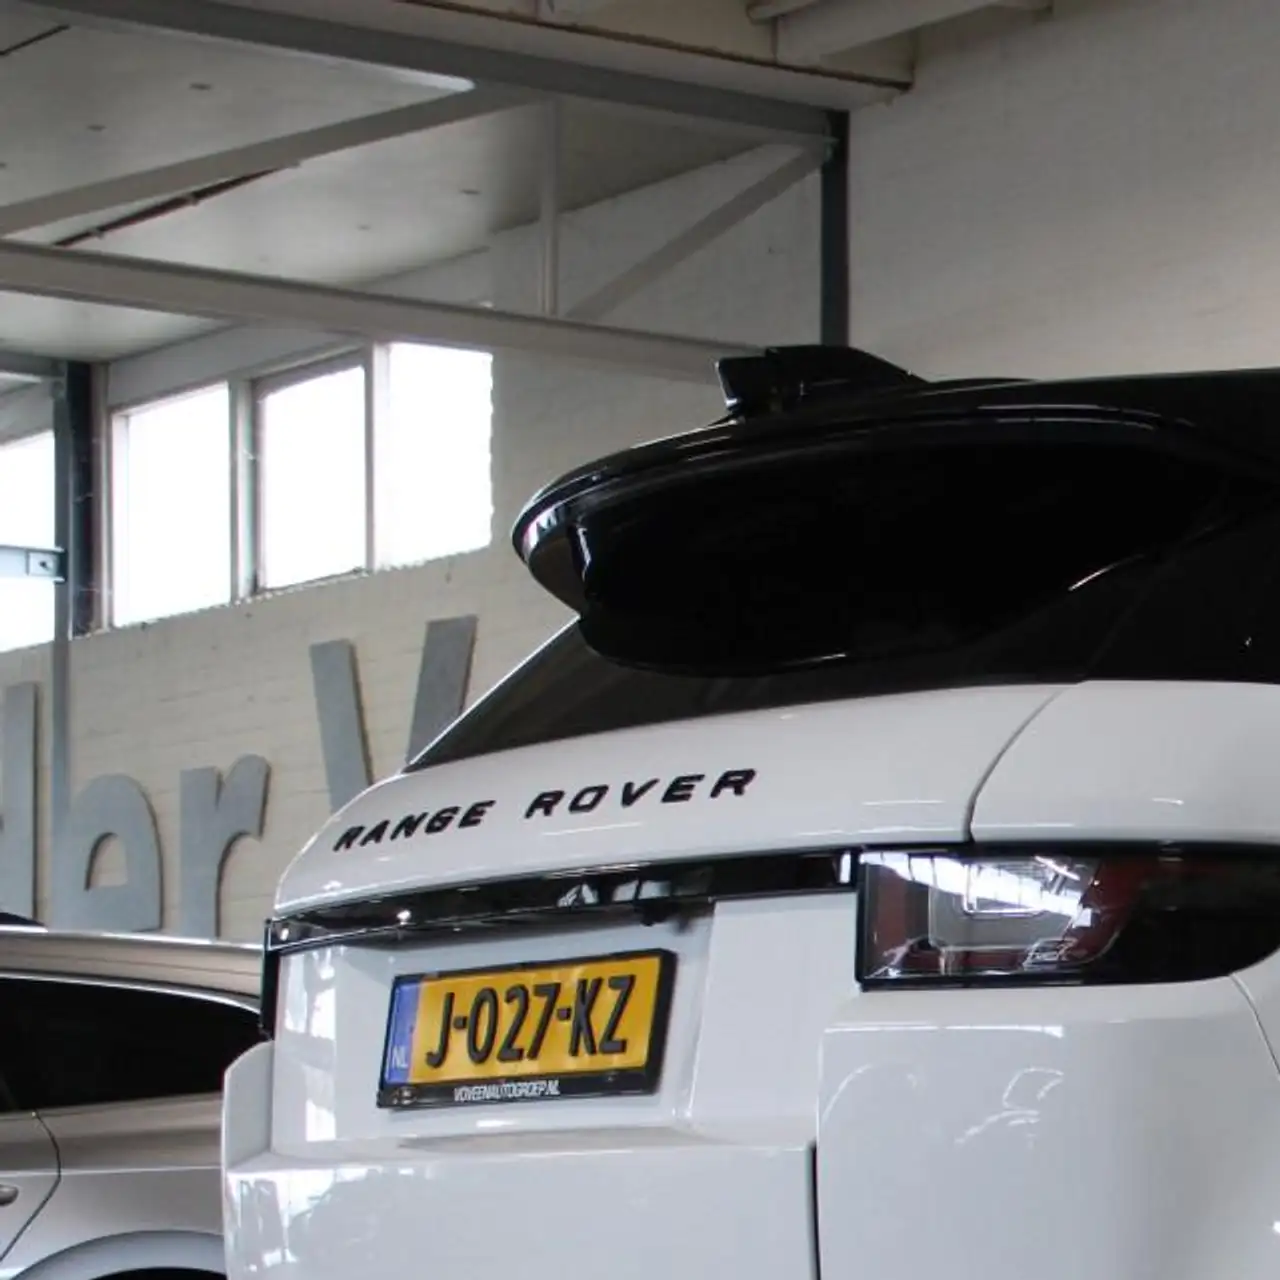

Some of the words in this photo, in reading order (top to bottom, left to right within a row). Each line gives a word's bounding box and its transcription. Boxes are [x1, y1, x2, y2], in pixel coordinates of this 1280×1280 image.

[332, 799, 496, 853] RANGE
[523, 768, 757, 820] ROVER
[425, 973, 637, 1069] J-027-KZ
